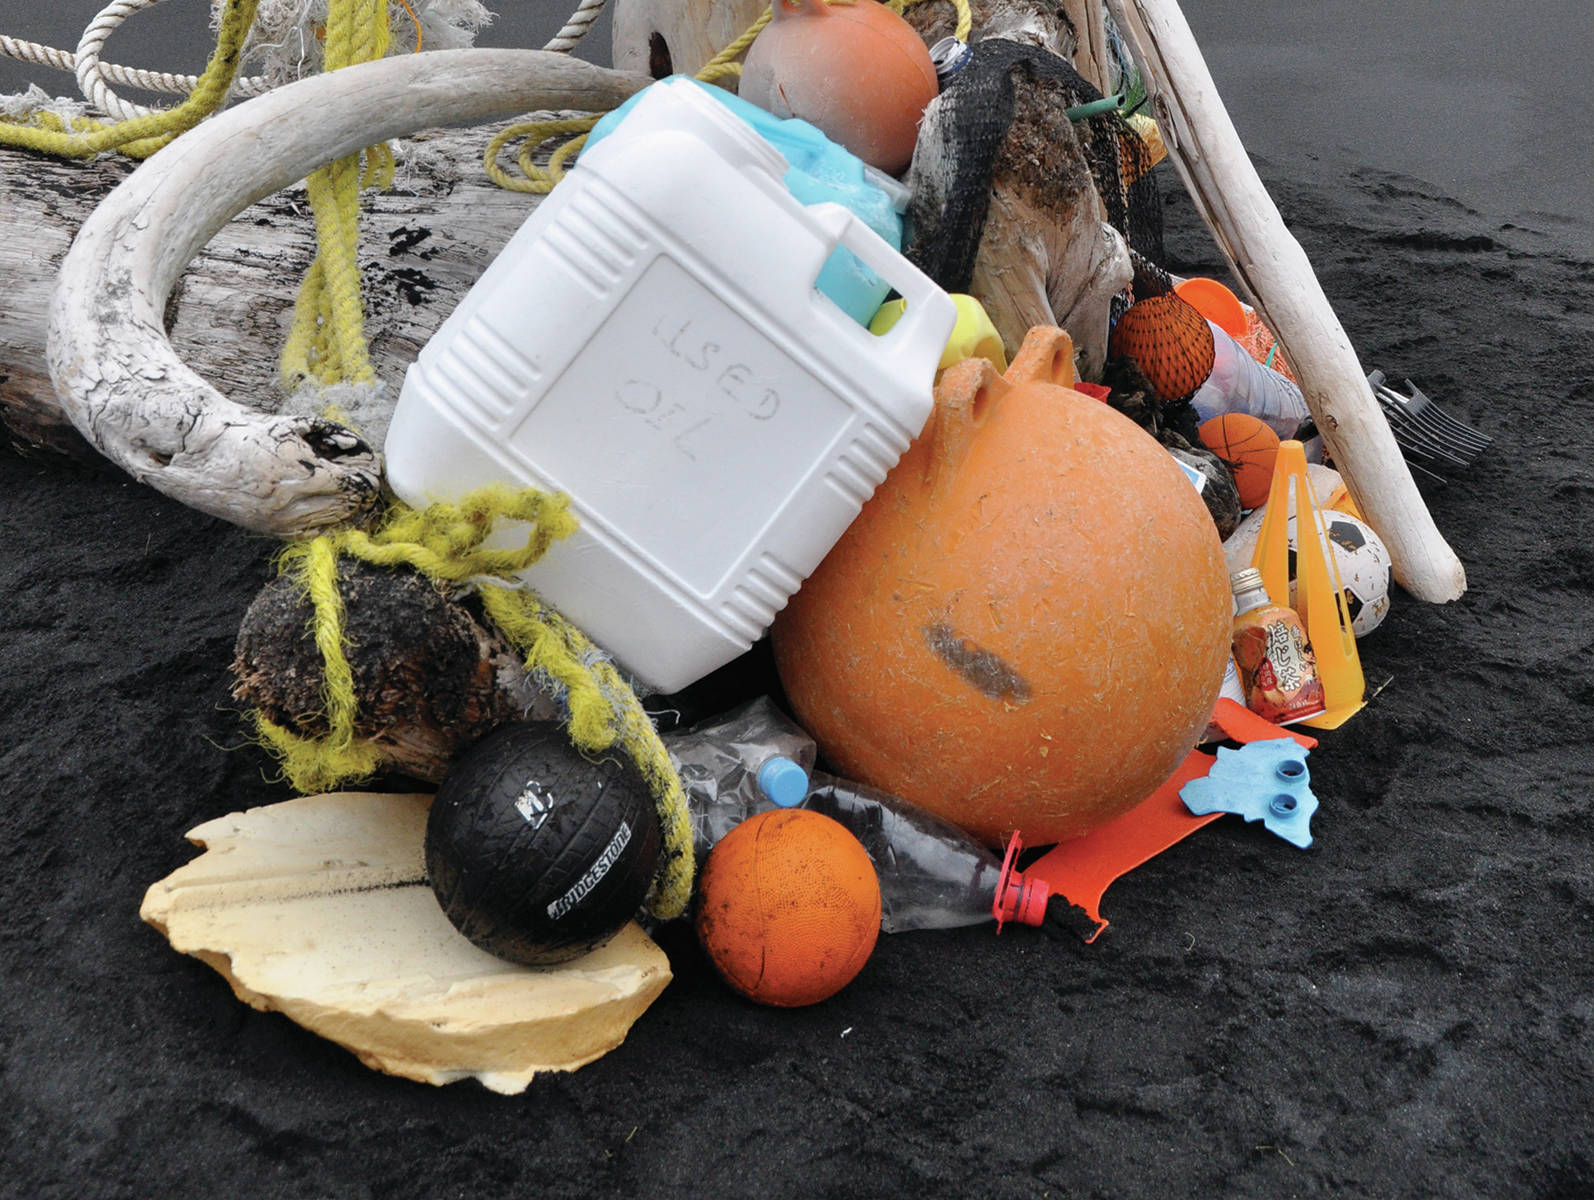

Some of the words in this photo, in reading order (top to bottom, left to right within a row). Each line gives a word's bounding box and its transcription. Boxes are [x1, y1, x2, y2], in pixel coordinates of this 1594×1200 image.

[651, 314, 781, 421] USED
[615, 378, 713, 462] OIL
[1267, 620, 1301, 692] 焙じ茶
[548, 821, 632, 920] BRIDGESTONE
